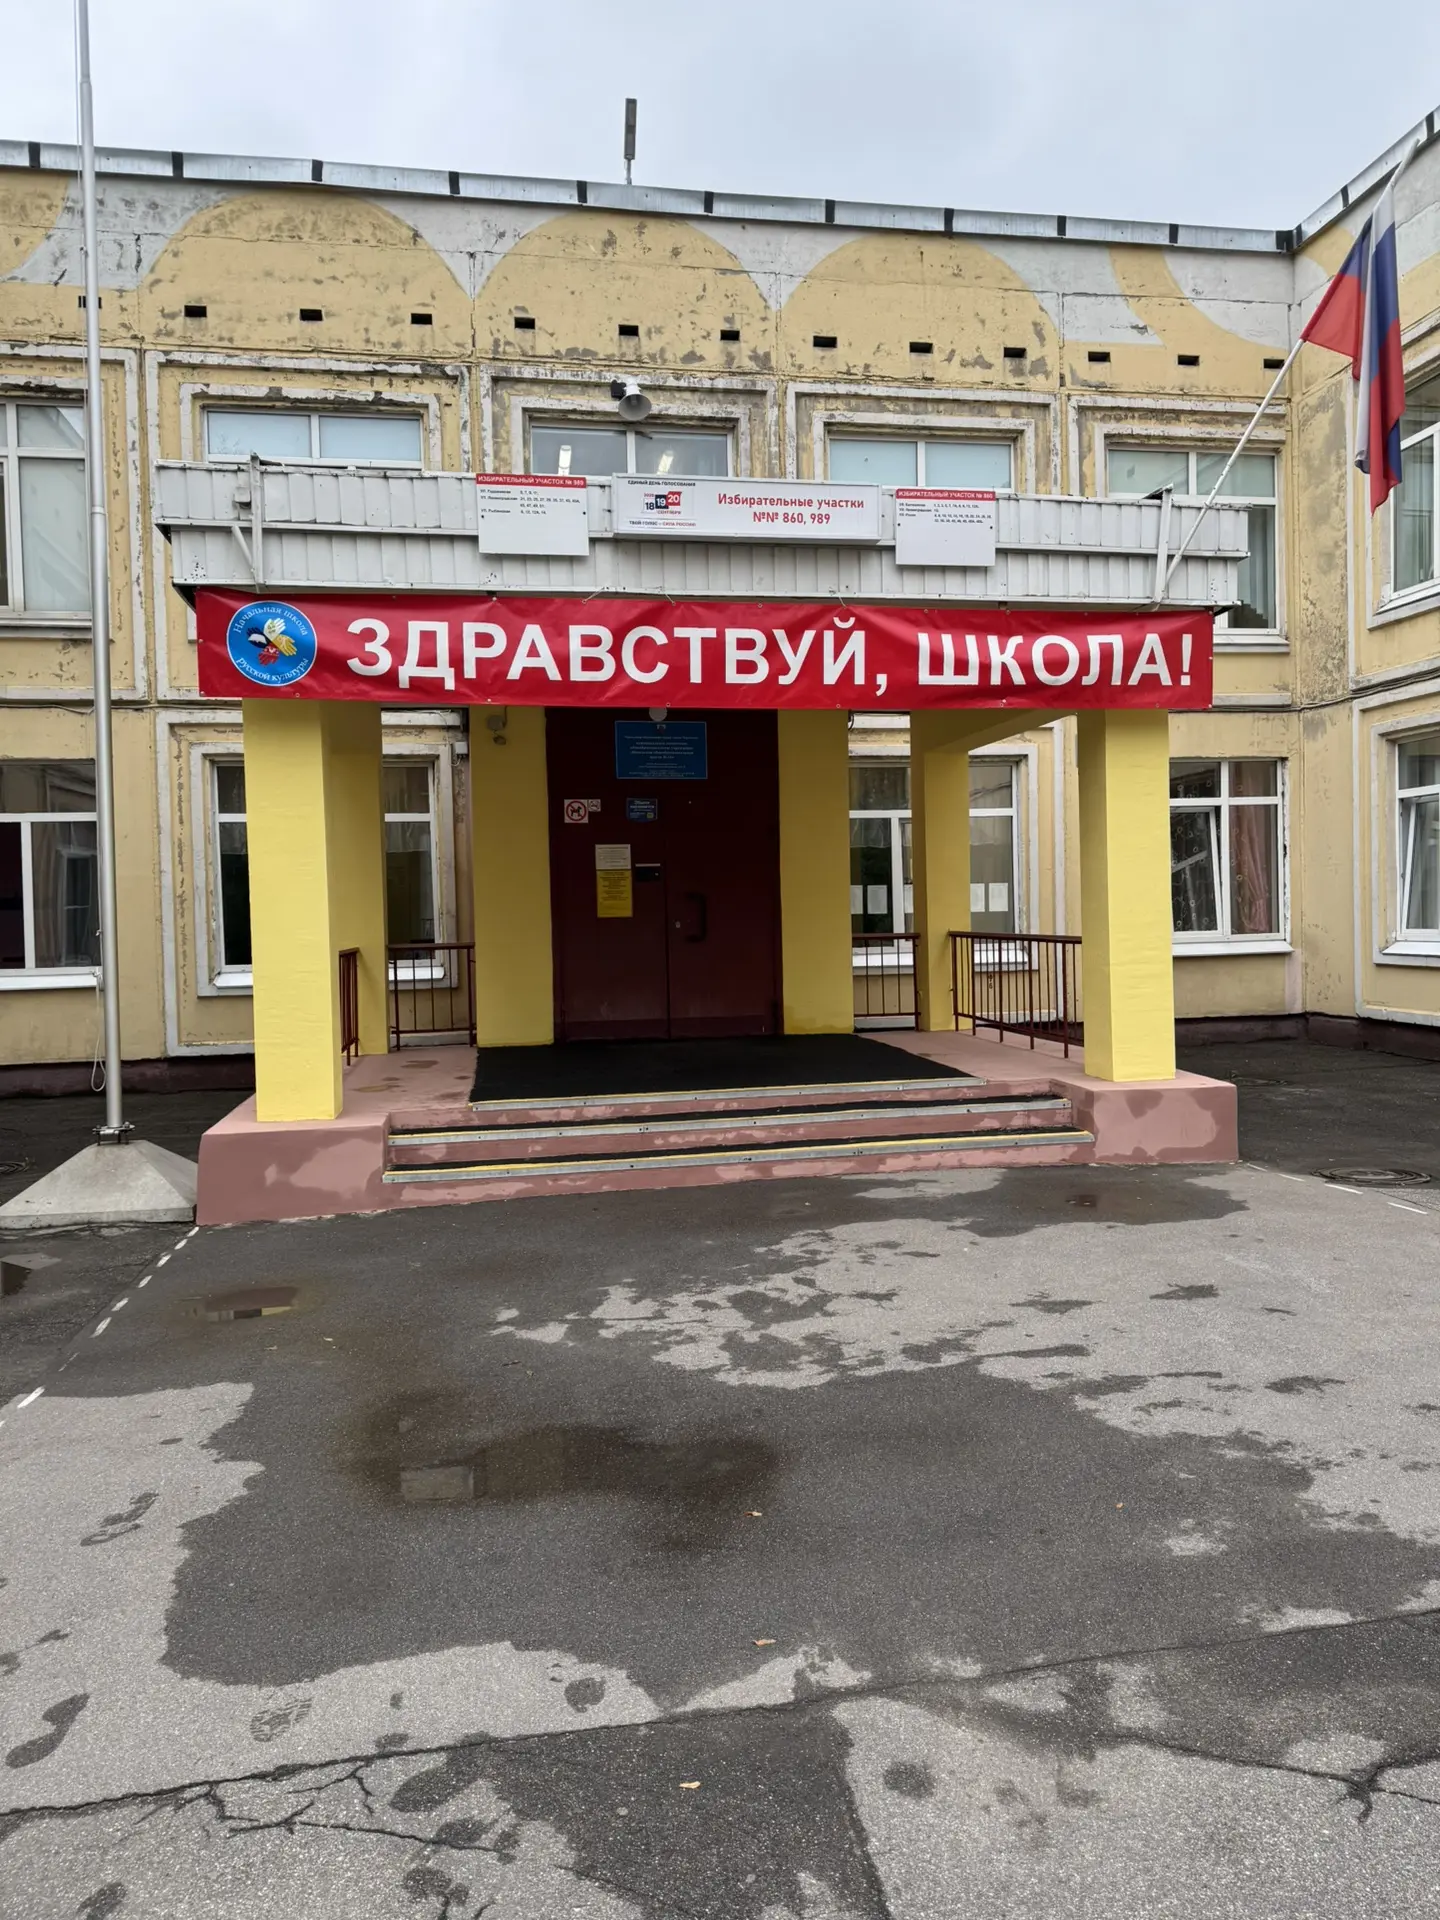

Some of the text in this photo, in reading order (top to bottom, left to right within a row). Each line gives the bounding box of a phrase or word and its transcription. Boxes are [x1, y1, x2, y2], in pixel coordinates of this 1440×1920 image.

[478, 475, 534, 484] ИЗБИРАТЕЛЬНЫЙ
[645, 495, 679, 510] 18 19 20
[718, 493, 864, 510] Избирательные участки
[753, 511, 831, 525] №№ 860, 989
[233, 606, 308, 636] Начальная школа
[346, 616, 1193, 696] ЗДРАВСТВУЙ, ШКОЛА!
[236, 657, 309, 683] русской культуры
